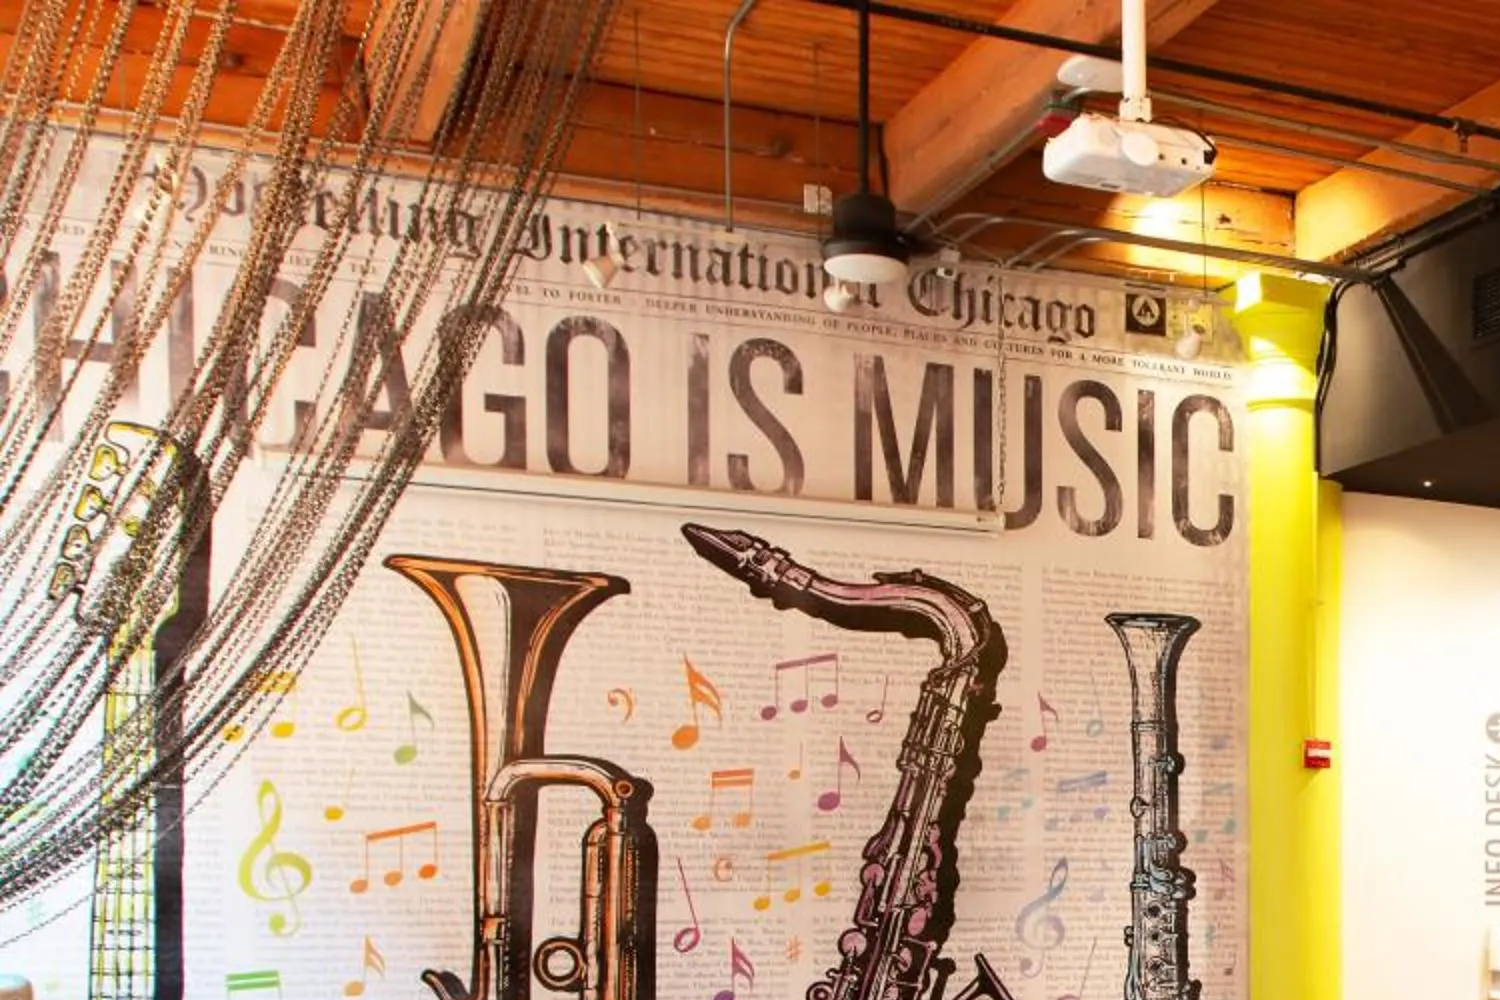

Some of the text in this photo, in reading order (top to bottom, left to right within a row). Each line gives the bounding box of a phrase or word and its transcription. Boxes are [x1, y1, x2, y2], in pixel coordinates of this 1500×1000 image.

[513, 212, 880, 308] Internation
[908, 264, 1095, 345] Chicago
[645, 297, 697, 312] DEEPER
[705, 305, 816, 326] UNDERSTANDING
[823, 318, 840, 330] OF
[903, 329, 948, 343] PLACES
[954, 335, 977, 348] AND
[984, 339, 1044, 355] CUTURES
[1050, 346, 1073, 360] FOR
[1092, 354, 1125, 367] MORE
[0, 250, 1236, 548] HICAGO IS MUSIC
